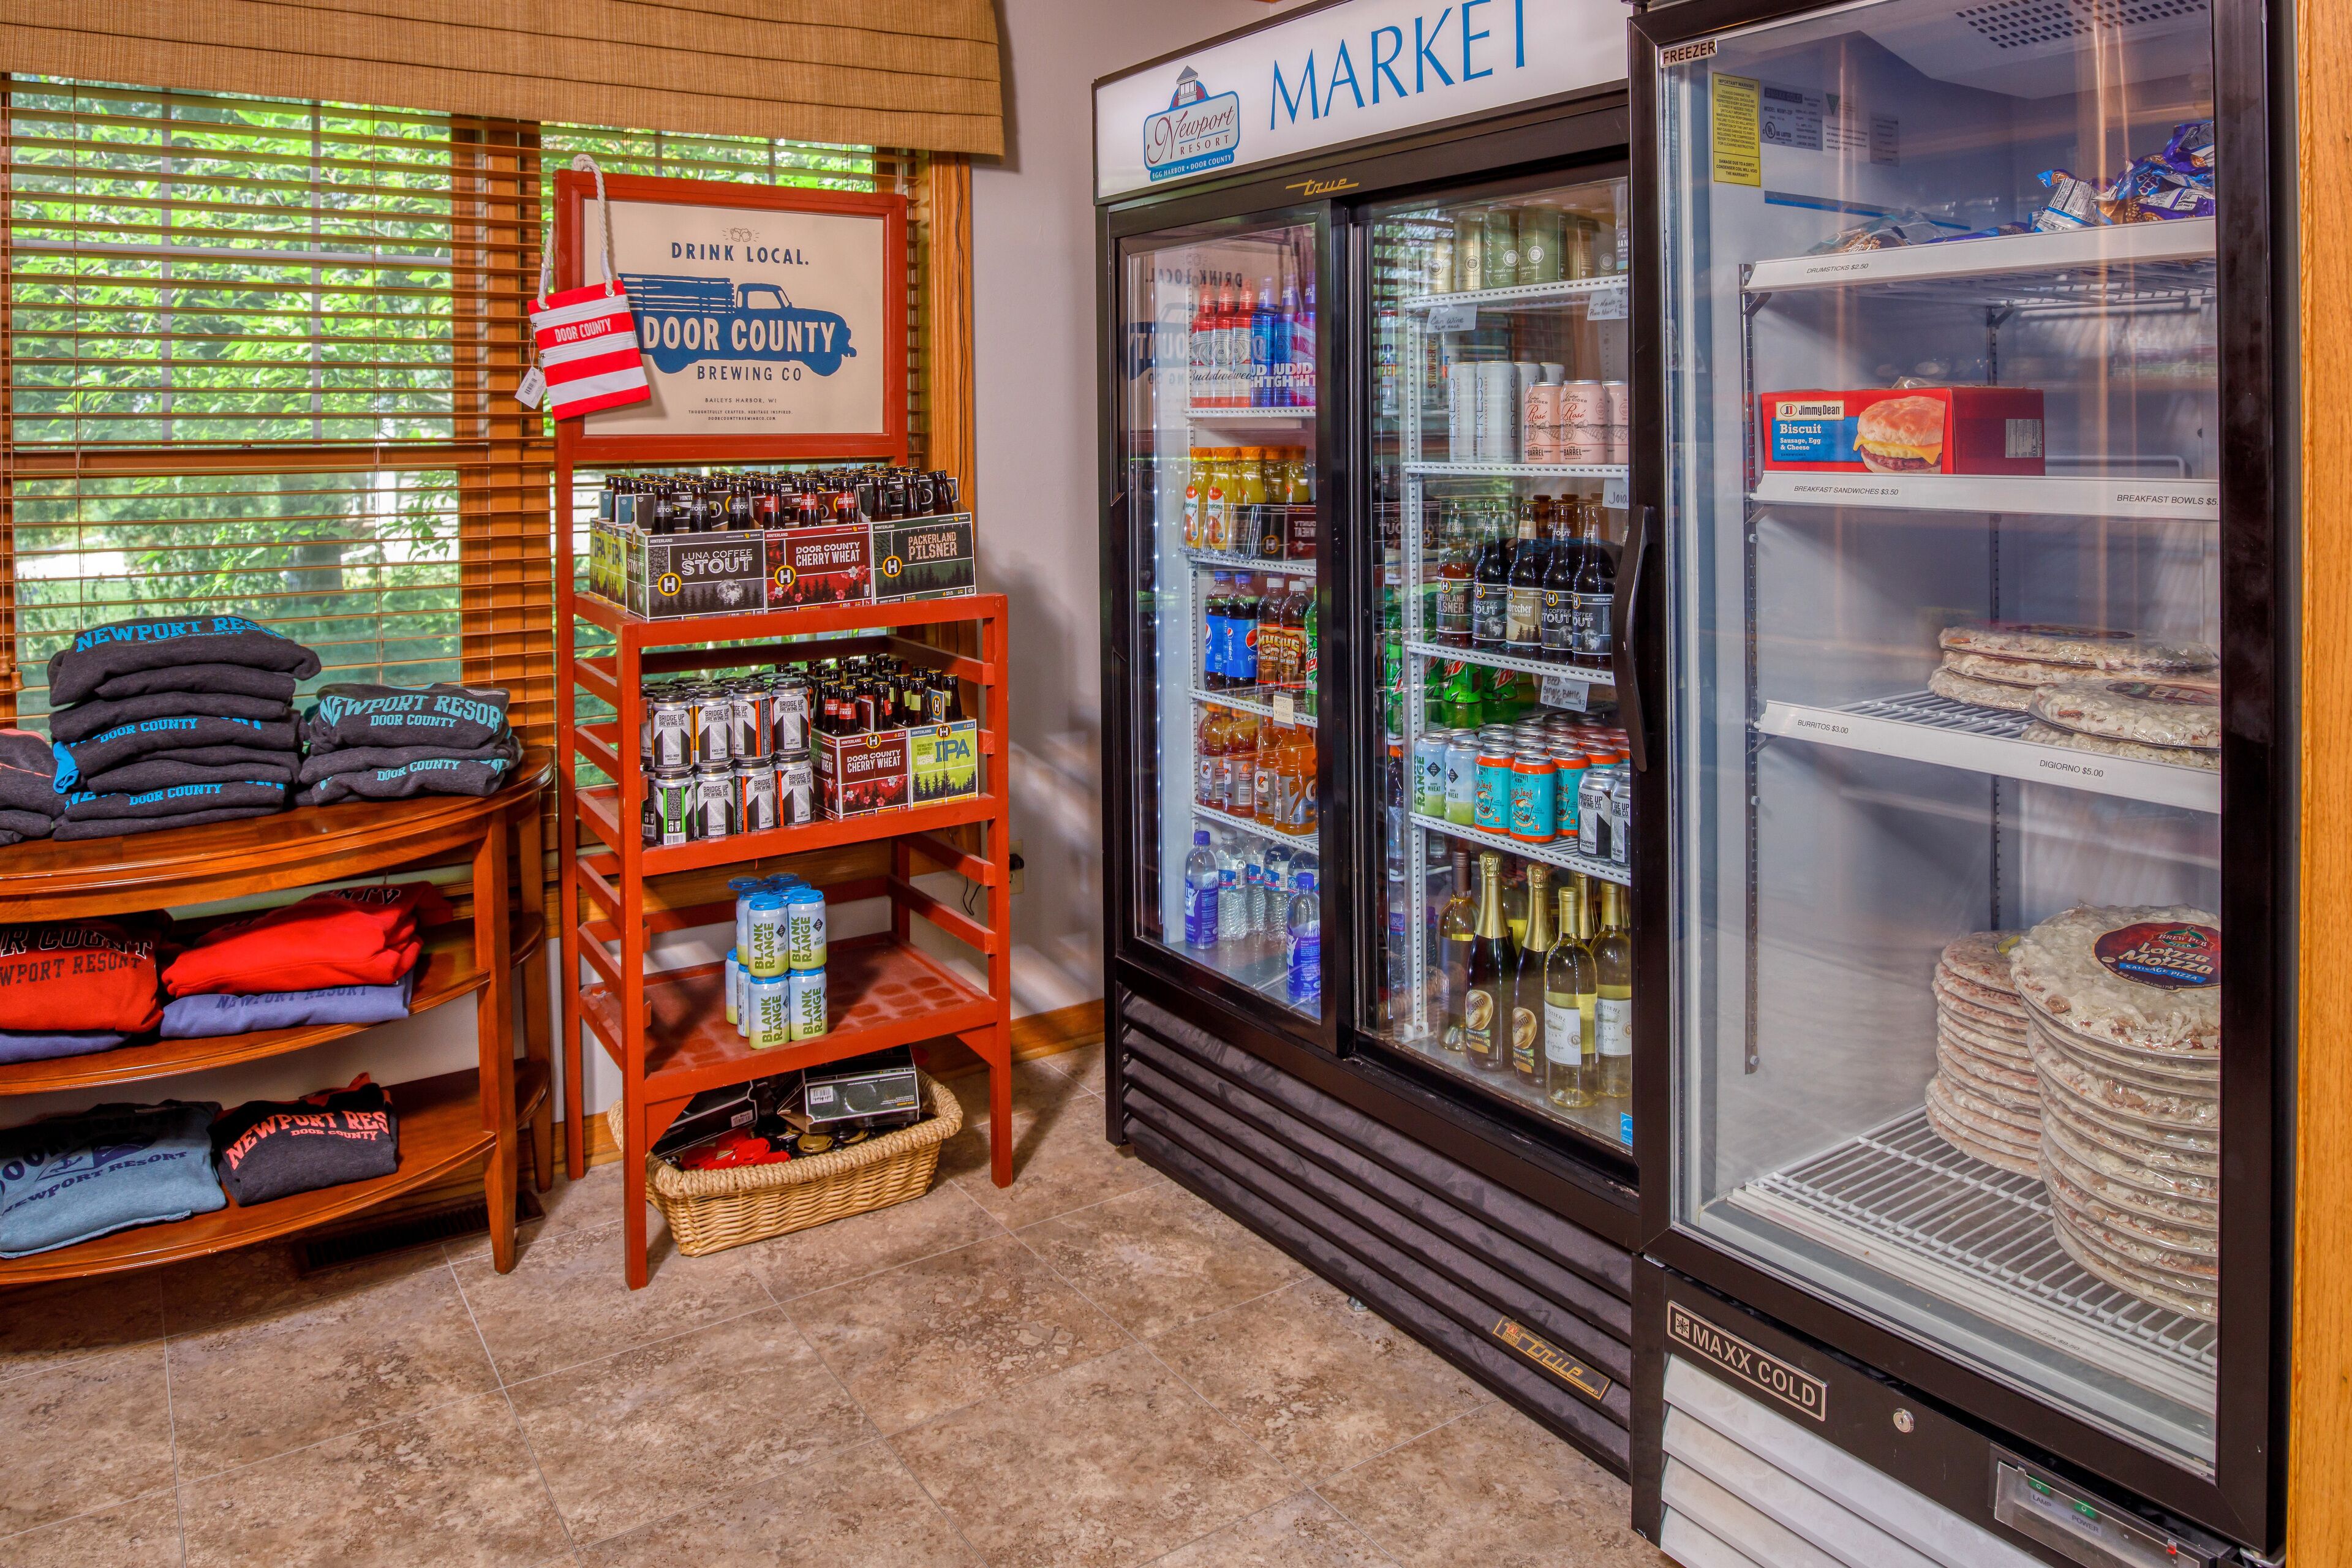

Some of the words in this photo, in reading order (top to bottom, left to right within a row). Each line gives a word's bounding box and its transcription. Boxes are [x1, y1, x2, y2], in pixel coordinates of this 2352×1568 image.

[1663, 40, 1716, 64] FREEZER
[1269, 0, 1525, 130] MARKET
[1147, 106, 1235, 164] Newport
[1180, 135, 1229, 155] RESORT
[1153, 170, 1162, 179] EGG
[1164, 165, 1185, 176] HARBOR
[1191, 160, 1207, 170] DOOR
[1208, 154, 1231, 165] COUNTY
[671, 242, 734, 262] DRINK
[747, 246, 810, 265] LOCAL.
[1806, 265, 1850, 274] DRUMSTICKS
[1850, 263, 1868, 271] $2.50
[554, 323, 578, 343] DOOR
[579, 318, 611, 339] COUNTY
[644, 316, 720, 352] DOOR
[731, 319, 835, 353] COUNTY
[696, 365, 772, 381] BREWING
[782, 368, 802, 382] CO
[1526, 405, 1547, 421] Rosé
[1561, 403, 1586, 420] Rosé
[1799, 405, 1822, 416] Jimmy
[1823, 405, 1840, 415] Dean
[1780, 424, 1822, 434] Biscuit
[1794, 485, 1833, 494] BREAKFAST
[1833, 487, 1880, 496] SANDWICHES
[2117, 494, 2169, 503] BREAKFAST
[2171, 496, 2204, 506] BOWLS
[796, 545, 821, 554] DOOR
[823, 542, 860, 552] COUNTY
[908, 532, 956, 546] PACKERLAND
[682, 552, 710, 560] LUNA
[712, 549, 753, 558] COFFEE
[796, 552, 829, 567] CHERRY
[832, 549, 860, 564] WHEAT
[909, 542, 957, 561] PILSNER
[682, 556, 752, 575] STOUT
[76, 620, 202, 653] NEWPORT
[211, 617, 285, 639] RESO
[319, 695, 430, 727] NEWPORT
[434, 695, 503, 734] RESOR
[370, 714, 403, 727] DOOR
[406, 714, 458, 728] COUNTY
[100, 725, 136, 743] DOOR
[140, 718, 198, 732] COUNTY
[1797, 718, 1831, 731] BURRITOS
[1831, 724, 1849, 734] $3.00
[846, 753, 868, 763] DOOR
[869, 750, 900, 759] COUNTY
[935, 739, 971, 763] IPA
[377, 768, 407, 782] DOOR
[409, 759, 461, 773] COUNTY
[848, 760, 875, 774] CHERRY
[877, 756, 900, 768] WHEAT
[2039, 759, 2081, 774] DIGIORNO
[2081, 765, 2103, 778] $5.00
[1417, 755, 1425, 807] RANGE
[129, 790, 165, 805] DOOR
[167, 783, 222, 798] COUNTY
[38, 928, 153, 959] COUNT
[754, 923, 763, 969] BLANK
[764, 922, 774, 969] RANGE
[791, 916, 801, 962] BLANK
[801, 916, 812, 962] RANGE
[0, 959, 65, 986] WPORT
[72, 952, 141, 974] RESORT
[2119, 949, 2215, 974] Motzza
[2125, 964, 2168, 974] SAUSAGE
[2171, 971, 2198, 981] PIZZA
[761, 996, 772, 1043] BLANK
[772, 995, 783, 1042] RANGE
[802, 989, 813, 1035] BLANK
[813, 987, 823, 1034] RANGE
[225, 1110, 336, 1169] NEWPORT
[346, 1110, 389, 1135] RES
[290, 1128, 325, 1137] DOOR
[328, 1129, 378, 1141] COUNTY
[108, 1151, 187, 1173] RESORT
[2033, 1329, 2056, 1341] PIZZA
[1693, 1322, 1752, 1375] MAXX
[1757, 1360, 1816, 1407] COLD
[2032, 1493, 2052, 1509] LAMP
[2071, 1514, 2099, 1533] POWER
